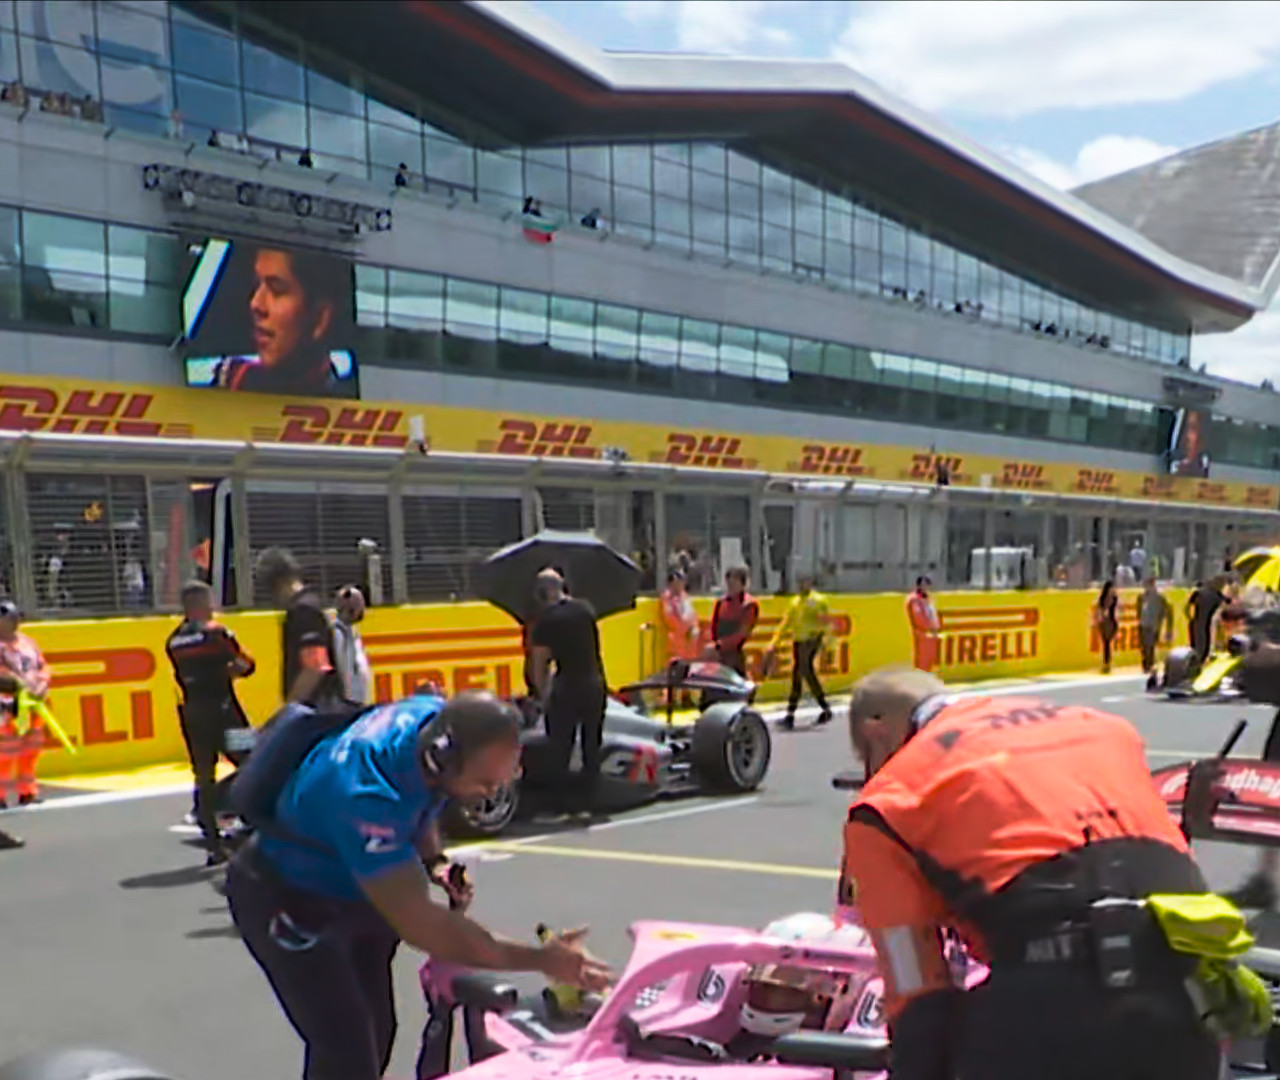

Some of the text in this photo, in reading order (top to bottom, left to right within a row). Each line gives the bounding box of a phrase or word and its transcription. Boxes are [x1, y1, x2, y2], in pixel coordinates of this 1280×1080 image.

[279, 403, 409, 448] DHL
[495, 419, 598, 458] DHL
[665, 432, 745, 469] DHL
[800, 444, 865, 476] DHL
